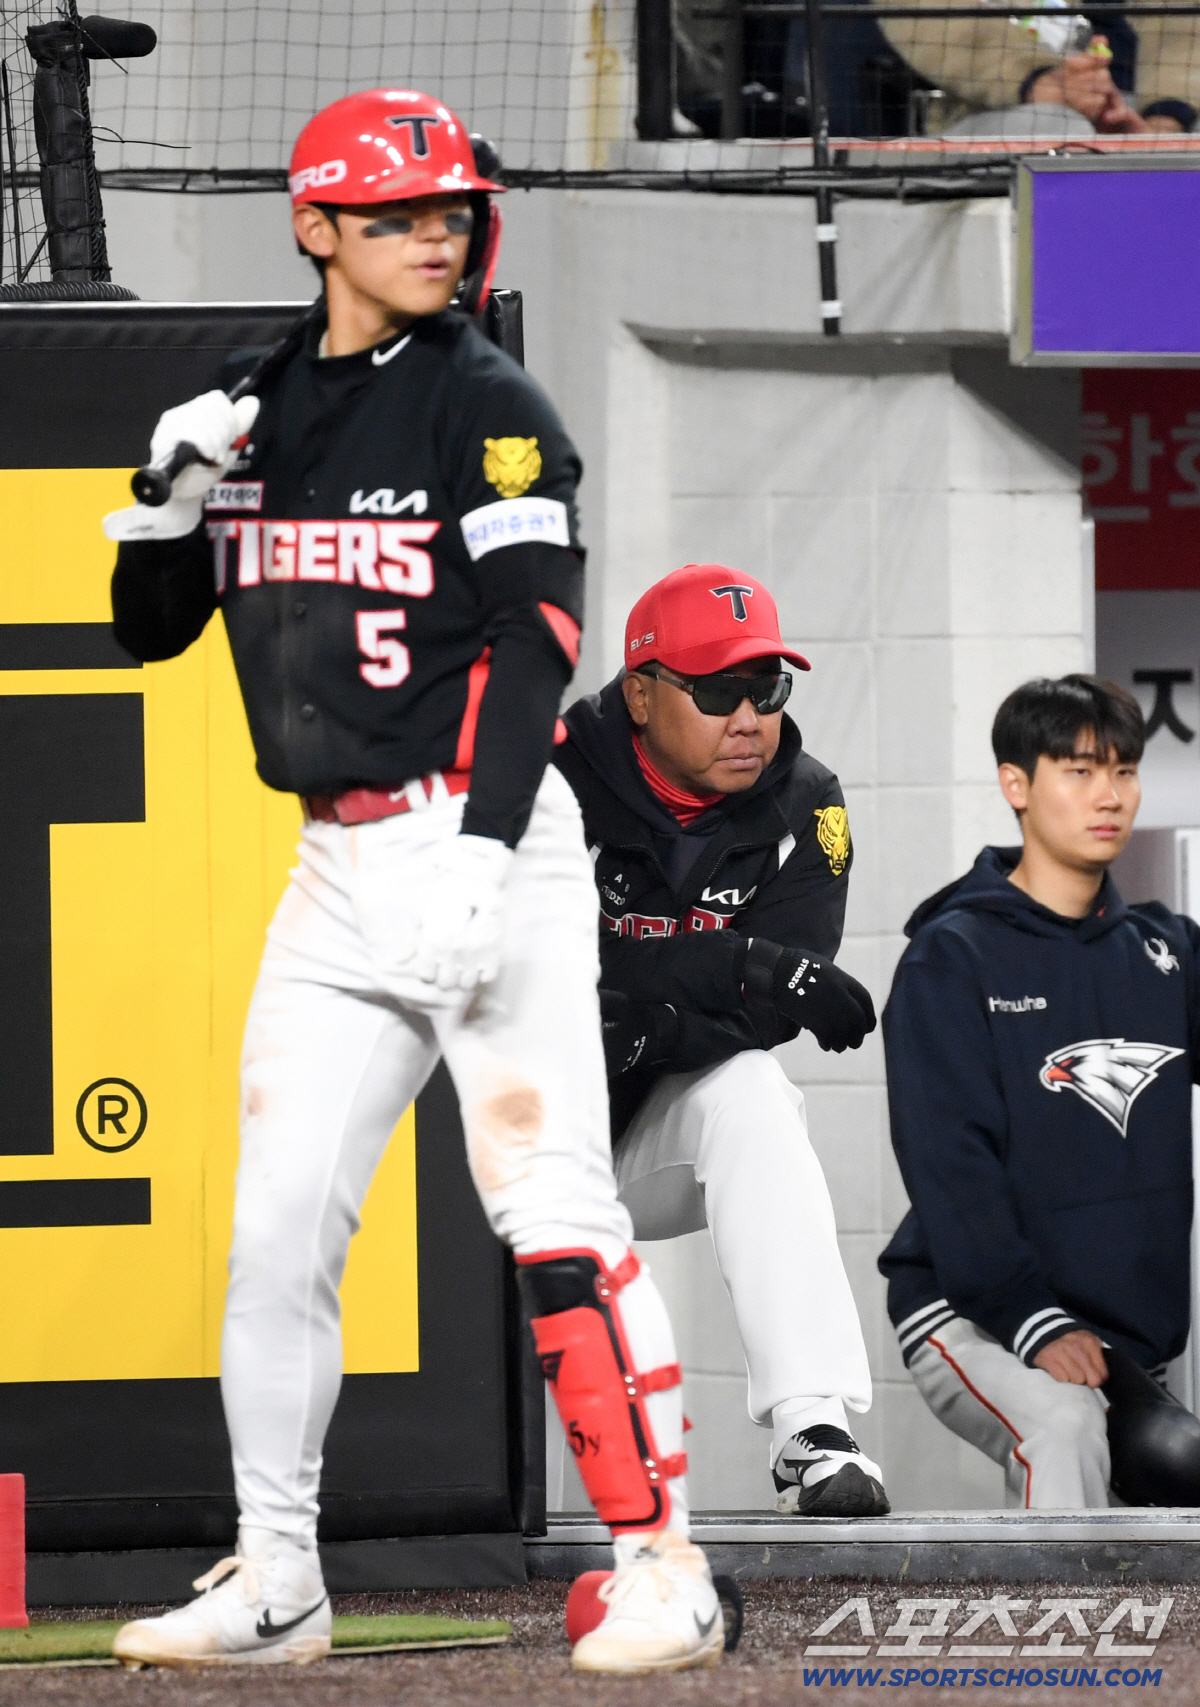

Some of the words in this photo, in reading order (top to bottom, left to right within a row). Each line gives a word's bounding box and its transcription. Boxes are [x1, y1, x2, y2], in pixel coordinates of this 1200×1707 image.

[385, 114, 441, 161] T
[350, 488, 428, 514] KIA
[206, 519, 442, 597] TIGERS
[709, 585, 753, 622] T
[355, 608, 411, 689] 5
[788, 958, 810, 989] STUDIO
